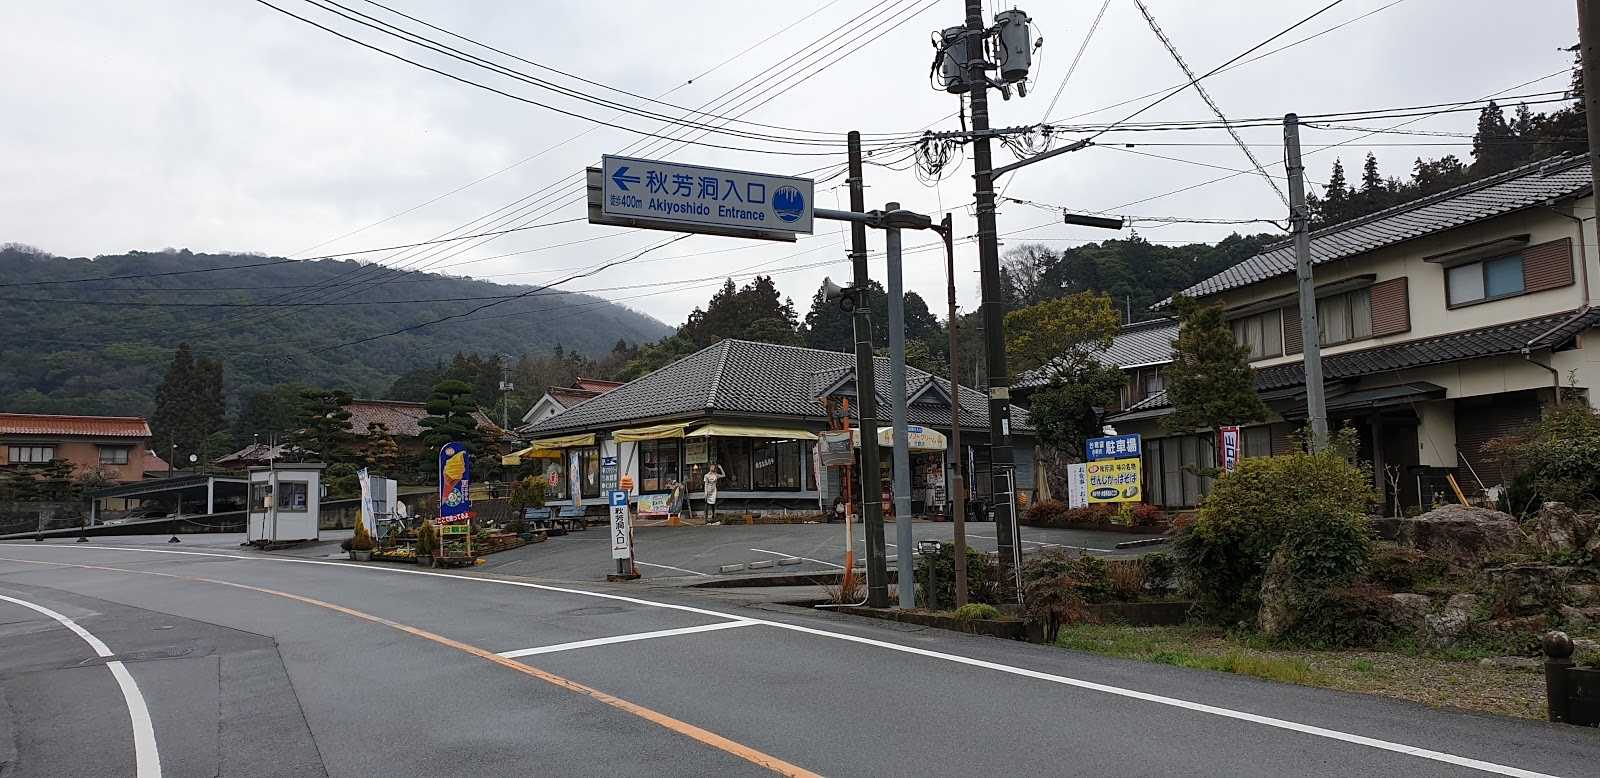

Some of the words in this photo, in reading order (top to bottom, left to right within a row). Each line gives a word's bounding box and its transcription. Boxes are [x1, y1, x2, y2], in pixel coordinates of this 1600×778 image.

[646, 170, 766, 204] 秋芳洞入口
[610, 193, 643, 209] 徒歩400m
[648, 198, 710, 216] Akiyoshido
[718, 205, 765, 221] Entrance
[1105, 438, 1137, 455] 駐車場
[613, 491, 625, 506] P
[615, 507, 625, 545] 秋芳洞入口
